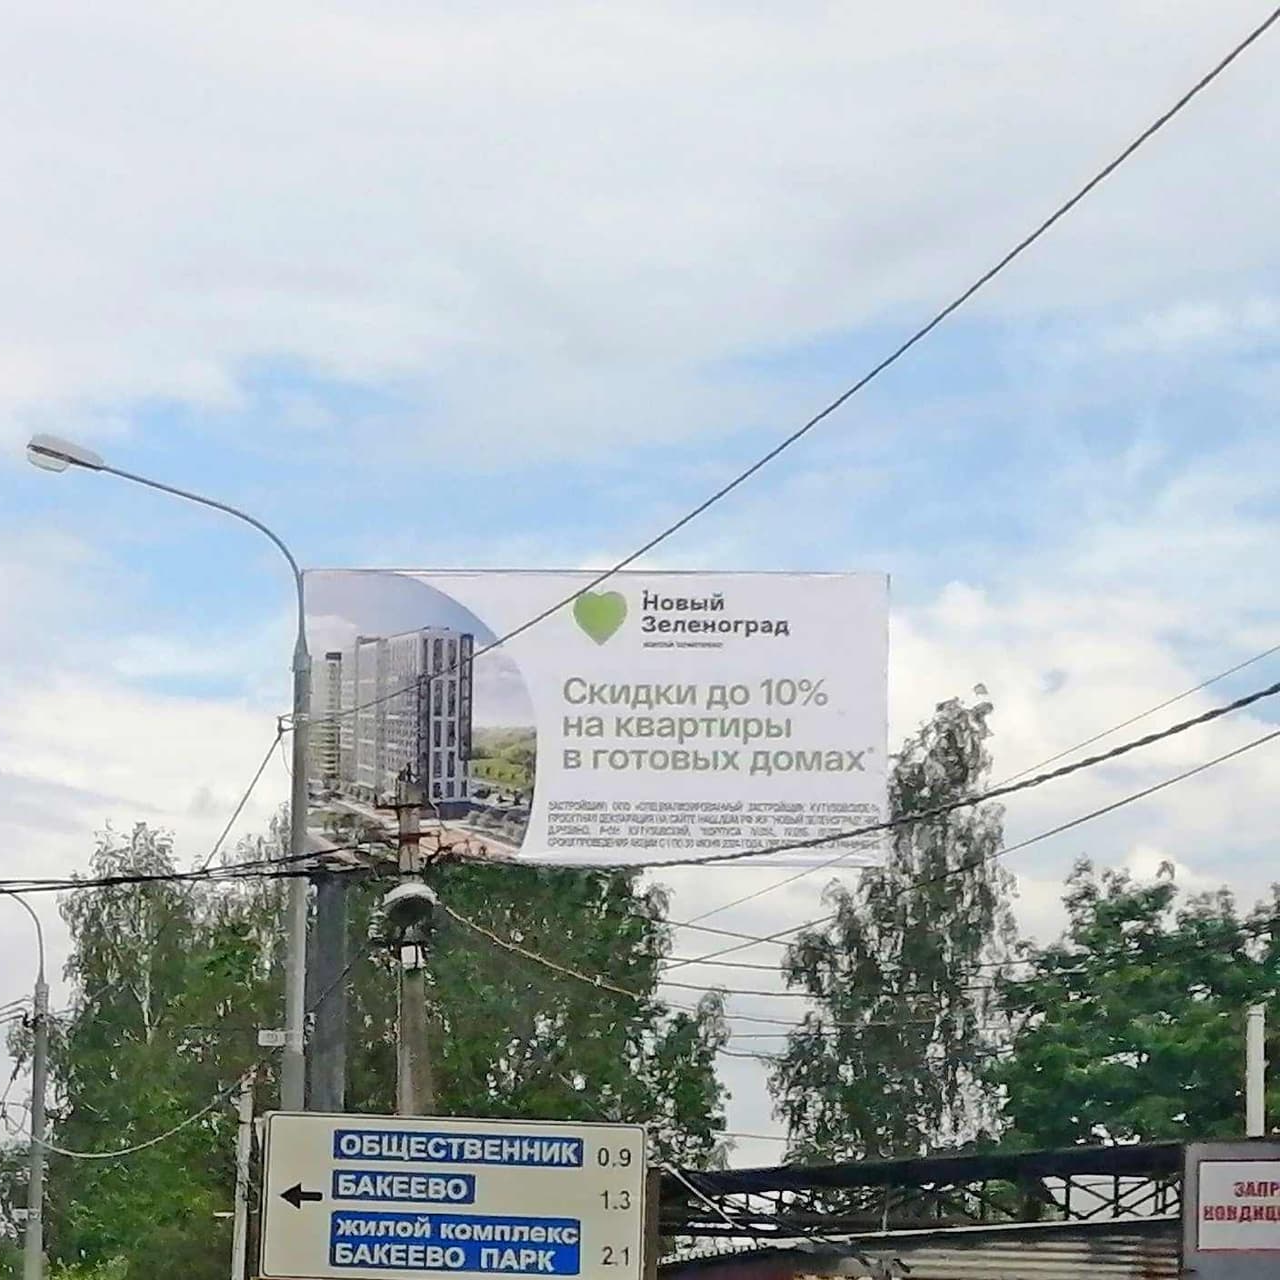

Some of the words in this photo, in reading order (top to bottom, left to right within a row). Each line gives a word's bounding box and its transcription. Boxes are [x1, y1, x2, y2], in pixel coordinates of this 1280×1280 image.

[642, 589, 725, 611] Новый
[641, 615, 790, 637] Зеленоград
[563, 677, 697, 709] Скидки
[706, 684, 750, 710] до
[760, 678, 829, 706] 10%
[563, 715, 604, 737] на
[615, 716, 792, 744] квартиры
[563, 749, 582, 769] в
[592, 749, 740, 770] готовых
[339, 1133, 579, 1165] ОБЩЕСТВЕННИК
[597, 1148, 632, 1168] 0.9
[338, 1173, 468, 1200] БАКЕЕВО
[600, 1190, 632, 1211] 1.3
[1204, 1205, 1280, 1222] КОНДИЦ
[335, 1243, 466, 1269] БАКЕЕВО
[480, 1246, 556, 1272] ПАРК
[601, 1246, 631, 1267] 2.1
